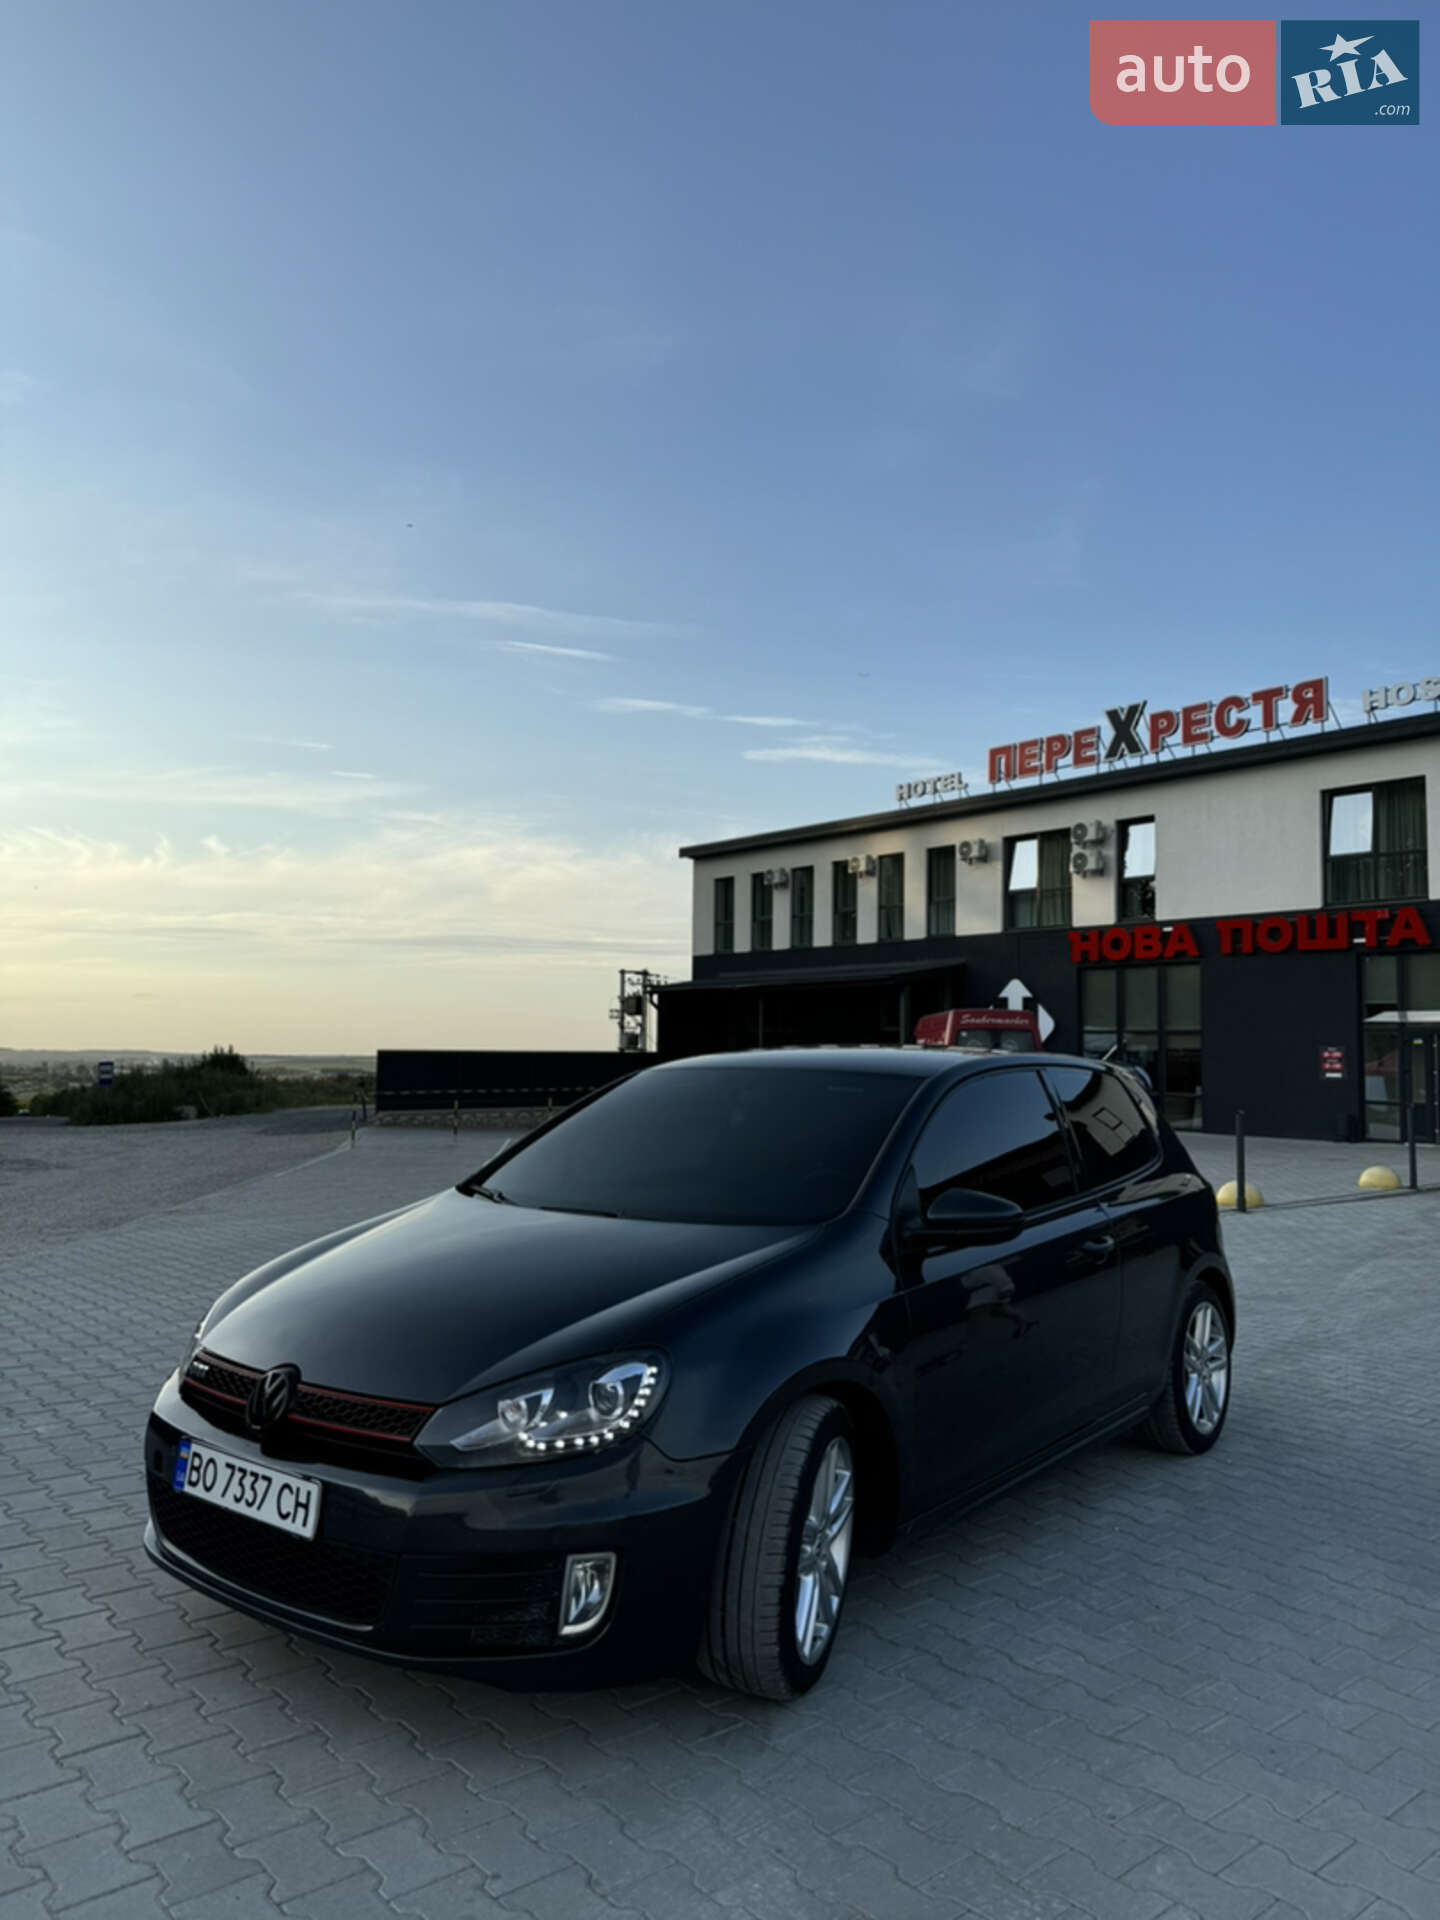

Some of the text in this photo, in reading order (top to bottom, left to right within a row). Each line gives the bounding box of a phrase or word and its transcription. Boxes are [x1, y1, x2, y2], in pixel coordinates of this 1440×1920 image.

[986, 676, 1329, 785] ПЕРЕХРЕСТЯ
[895, 771, 969, 802] HOTEL
[1067, 906, 1432, 965] НОВА ПОШТА
[187, 1451, 312, 1528] BO 7337 CH
